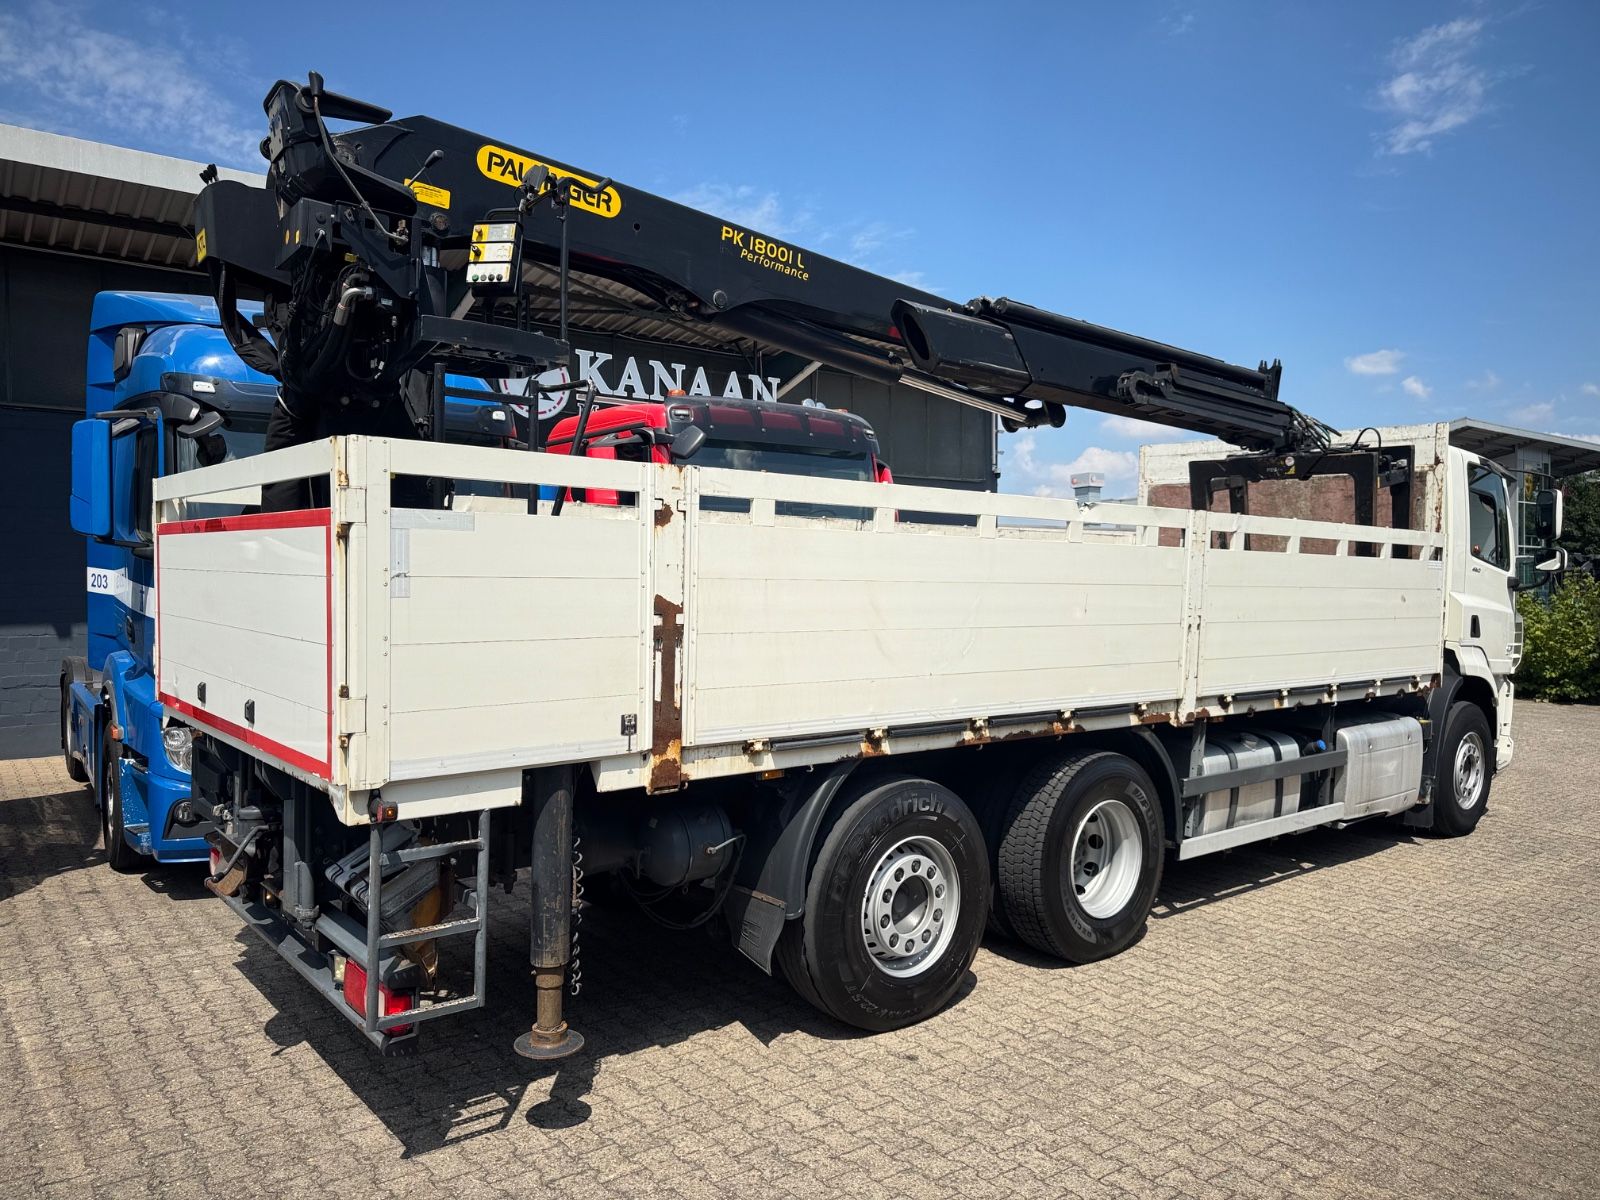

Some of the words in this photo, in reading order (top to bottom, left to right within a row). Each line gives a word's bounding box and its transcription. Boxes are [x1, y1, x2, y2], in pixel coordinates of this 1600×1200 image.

[486, 151, 613, 213] PALGER
[721, 225, 745, 247] PK
[749, 235, 793, 265] 18001
[797, 252, 805, 269] L
[740, 248, 809, 281] Performance
[575, 349, 780, 402] KANAAN
[91, 573, 108, 589] 203
